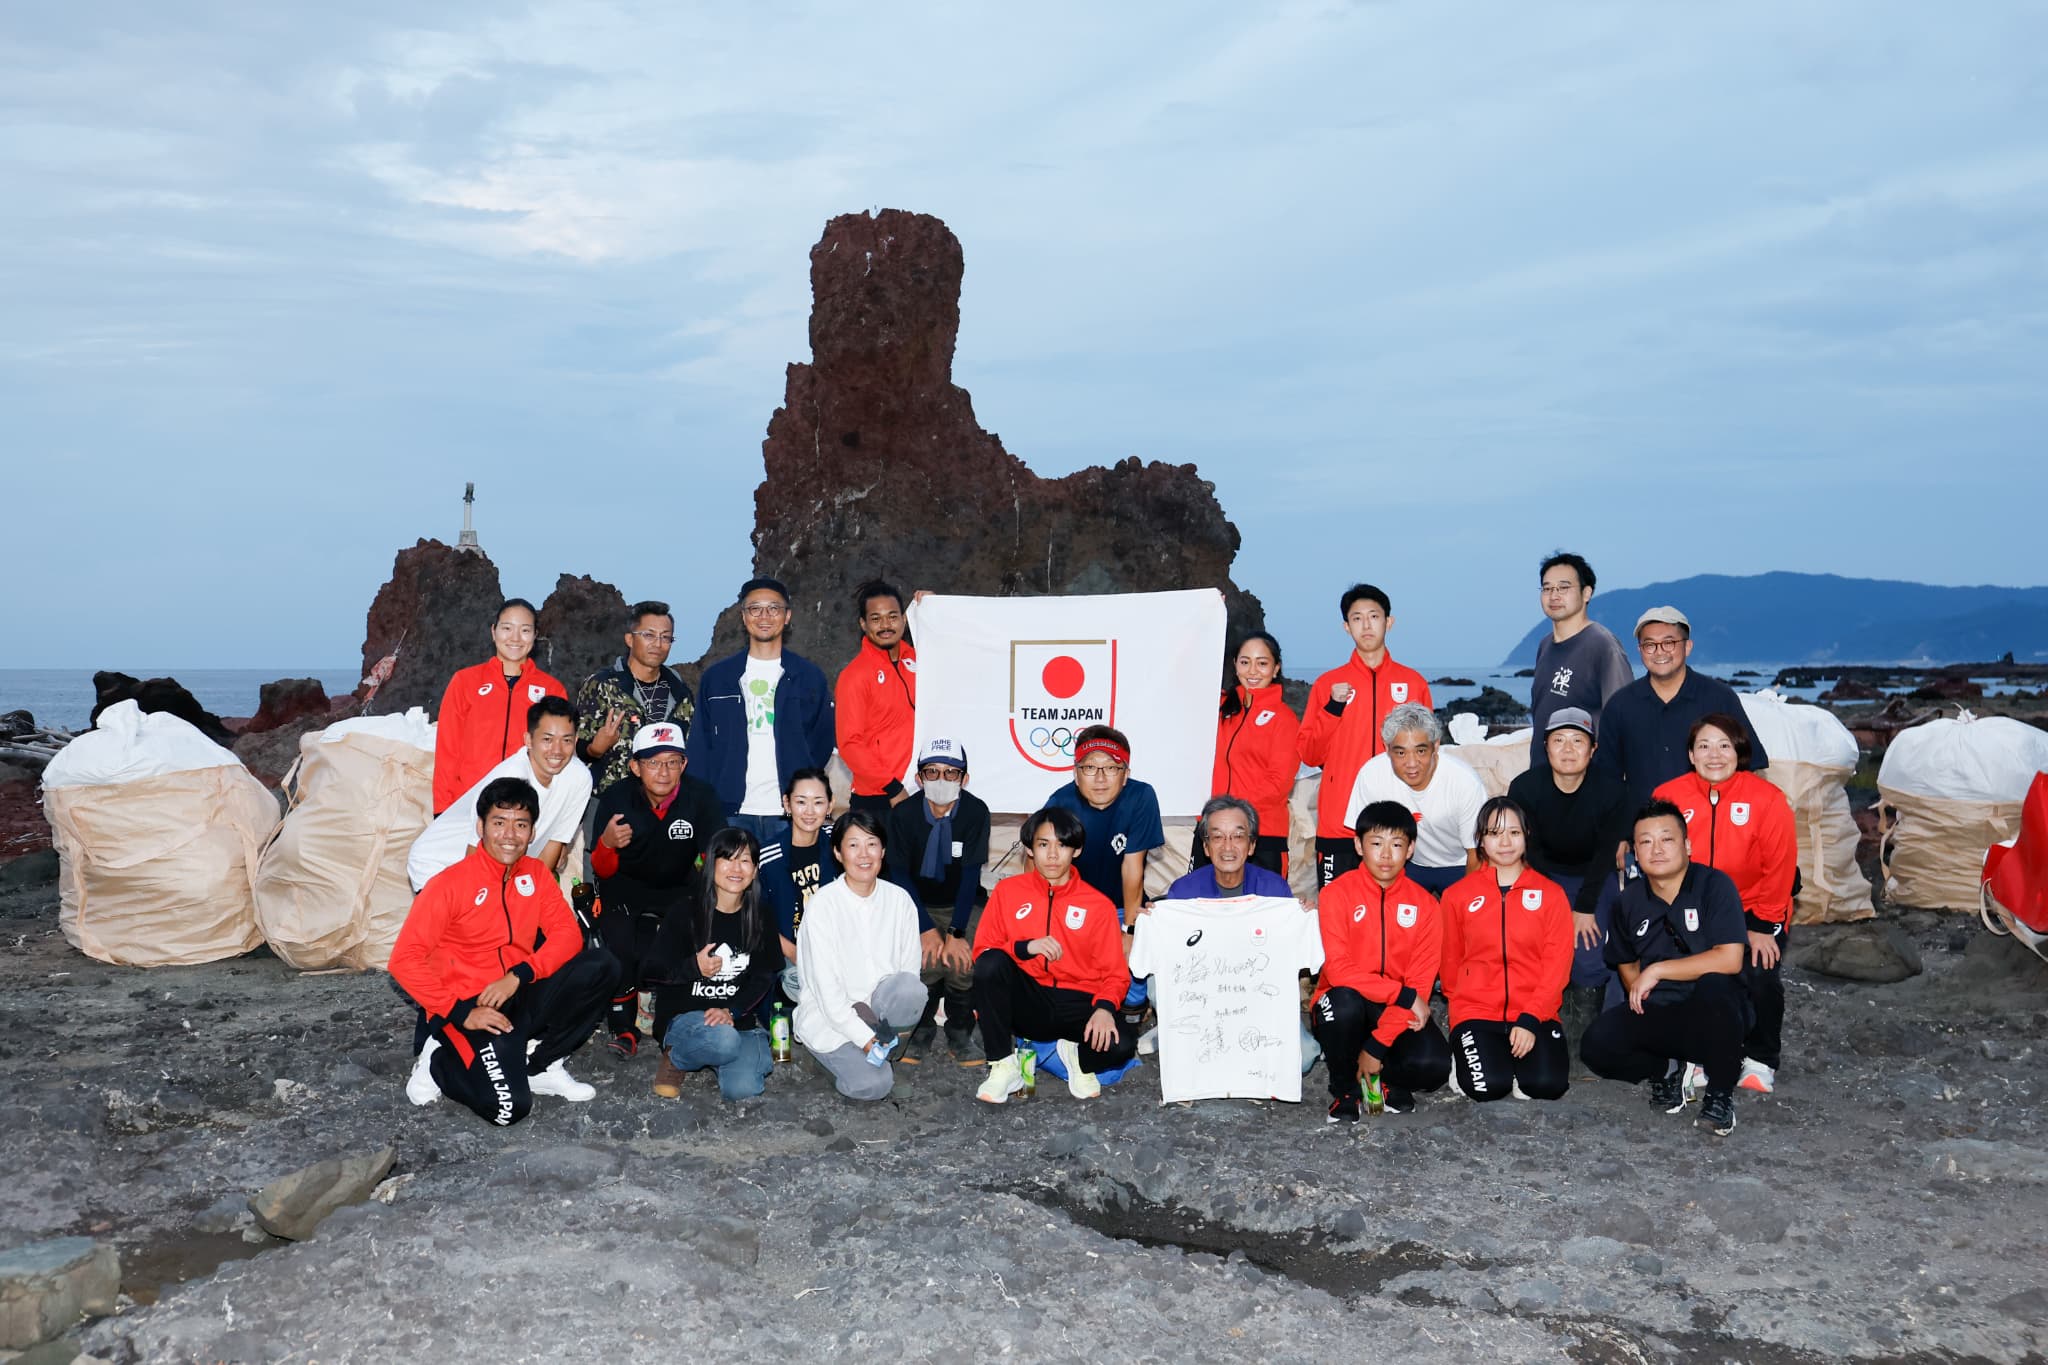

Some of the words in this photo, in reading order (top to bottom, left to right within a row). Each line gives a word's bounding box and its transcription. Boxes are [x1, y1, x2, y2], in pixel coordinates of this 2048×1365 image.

[1021, 708, 1058, 720] TEAM
[1061, 708, 1103, 720] JAPAN
[692, 982, 740, 997] ikade
[480, 1042, 505, 1081] TEAM
[1464, 1047, 1488, 1092] JAPAN
